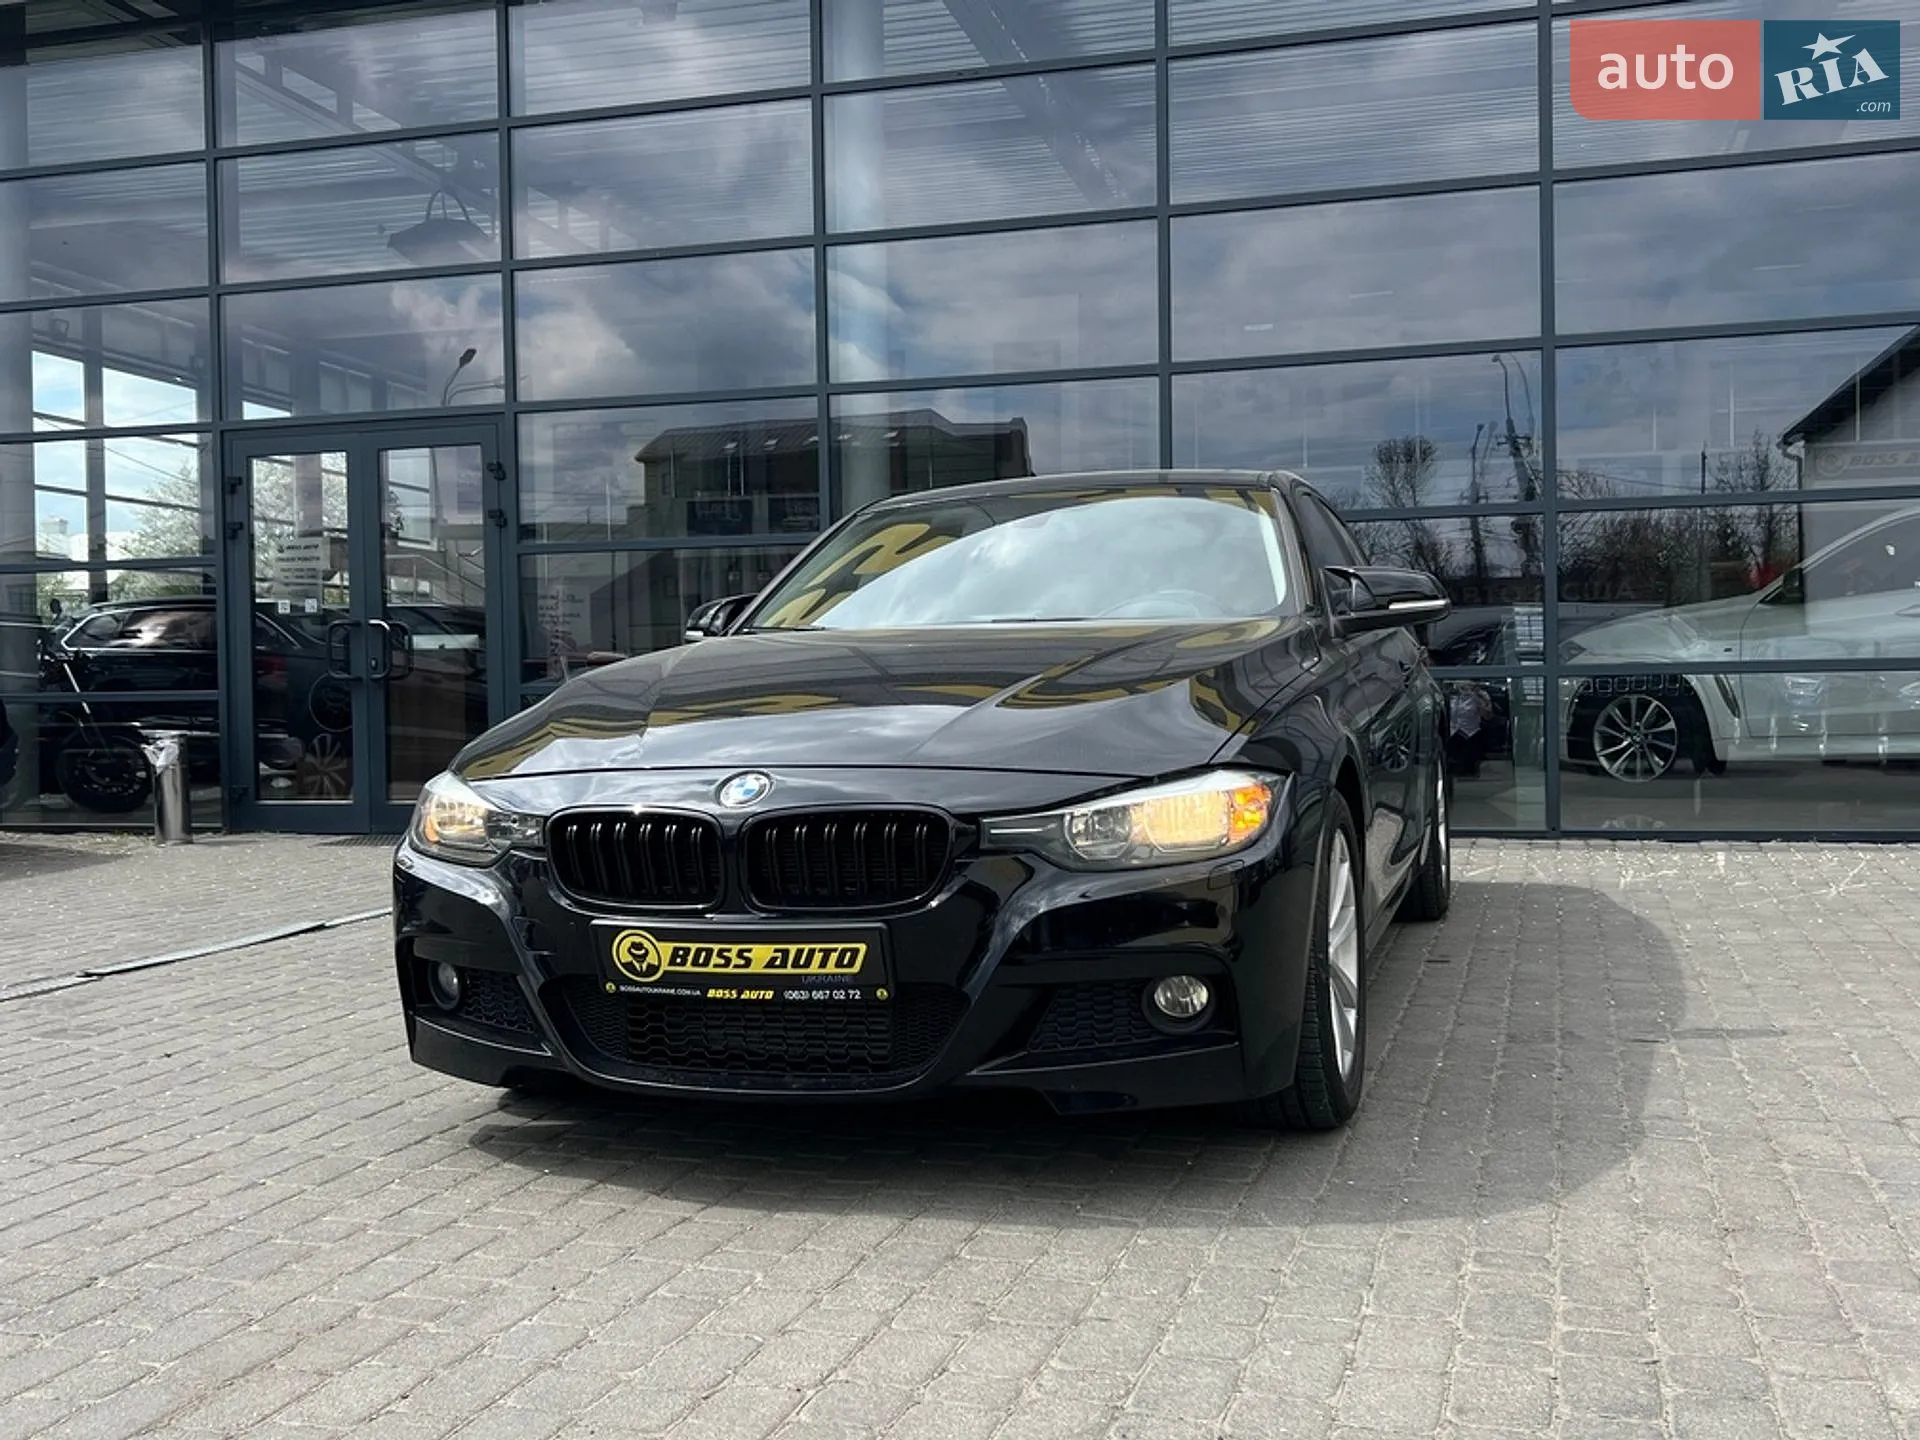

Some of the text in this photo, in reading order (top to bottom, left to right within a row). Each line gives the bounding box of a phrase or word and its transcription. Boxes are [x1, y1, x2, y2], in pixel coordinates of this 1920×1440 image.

[668, 946, 861, 969] BOSS AUTO
[706, 988, 738, 999] BOSS
[740, 989, 774, 1000] AUTO
[847, 989, 862, 1000] 72
